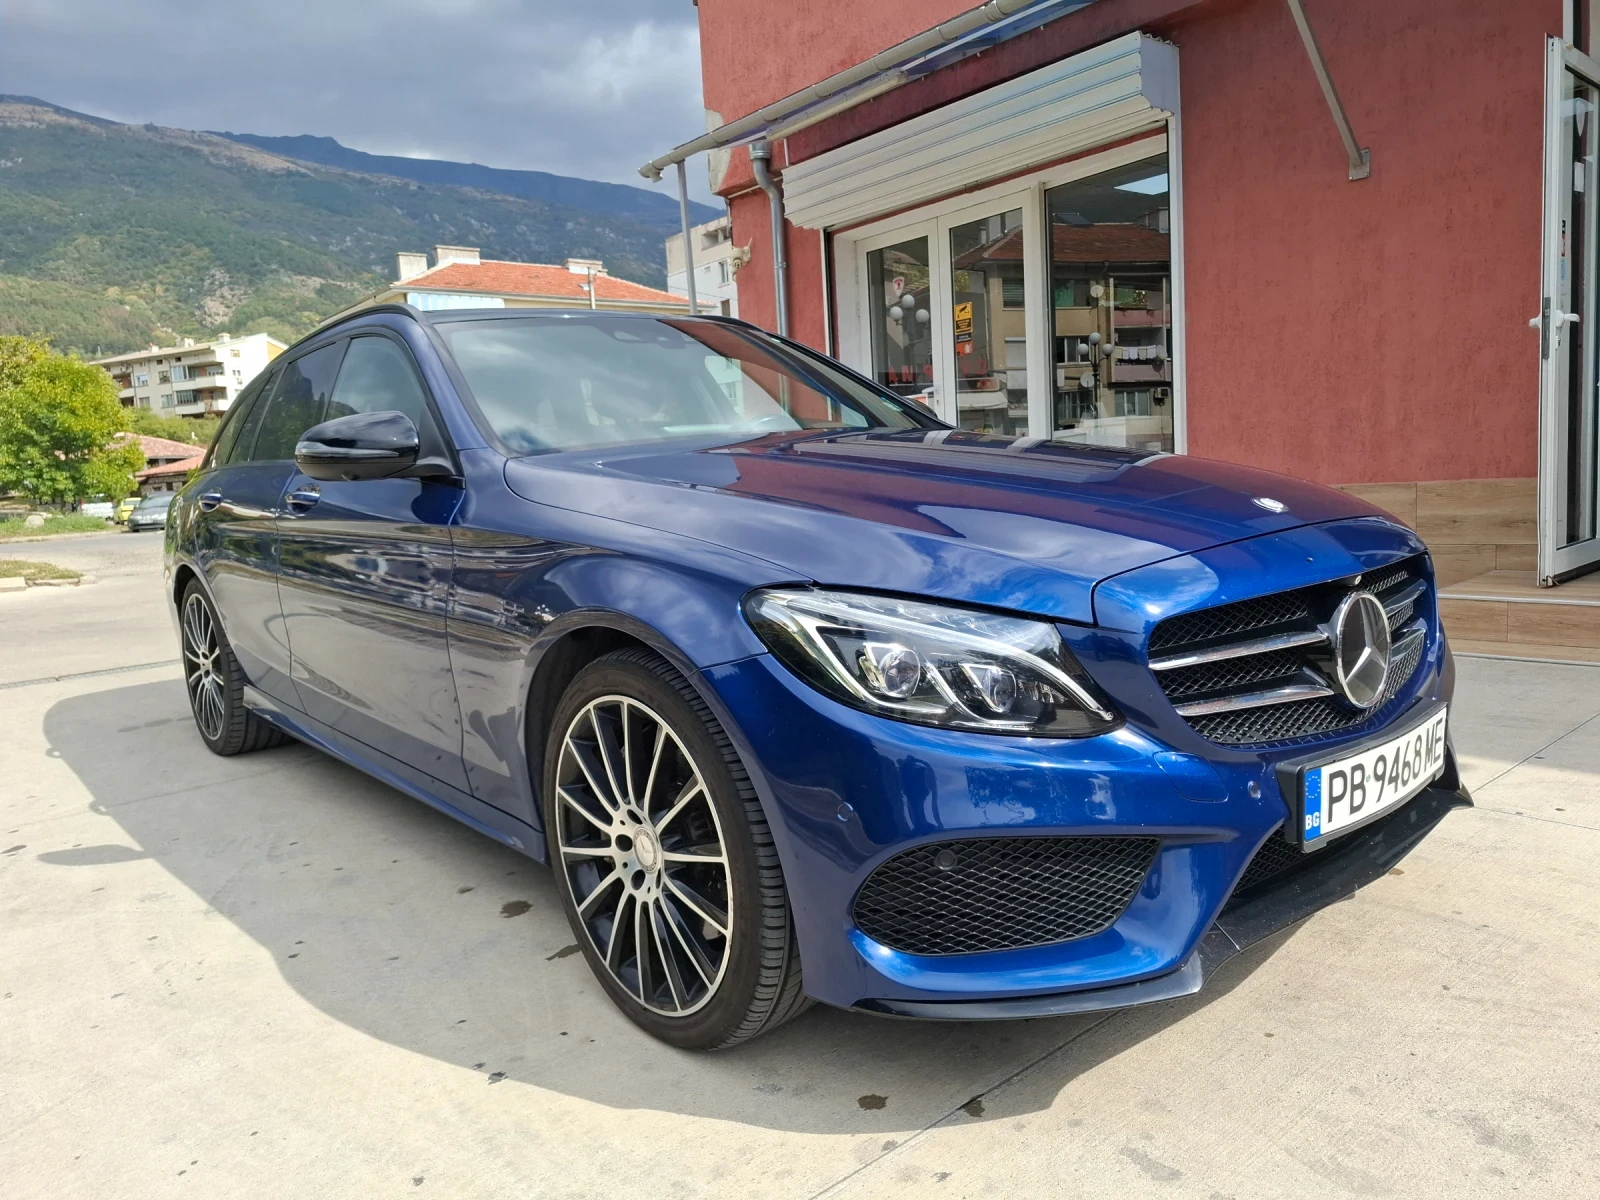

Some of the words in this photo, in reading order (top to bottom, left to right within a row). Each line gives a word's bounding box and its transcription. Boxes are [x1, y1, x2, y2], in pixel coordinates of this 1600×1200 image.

[1327, 763, 1367, 823] PB
[1373, 734, 1423, 804] 9468
[1424, 717, 1444, 774] ME
[1305, 812, 1320, 831] BG
